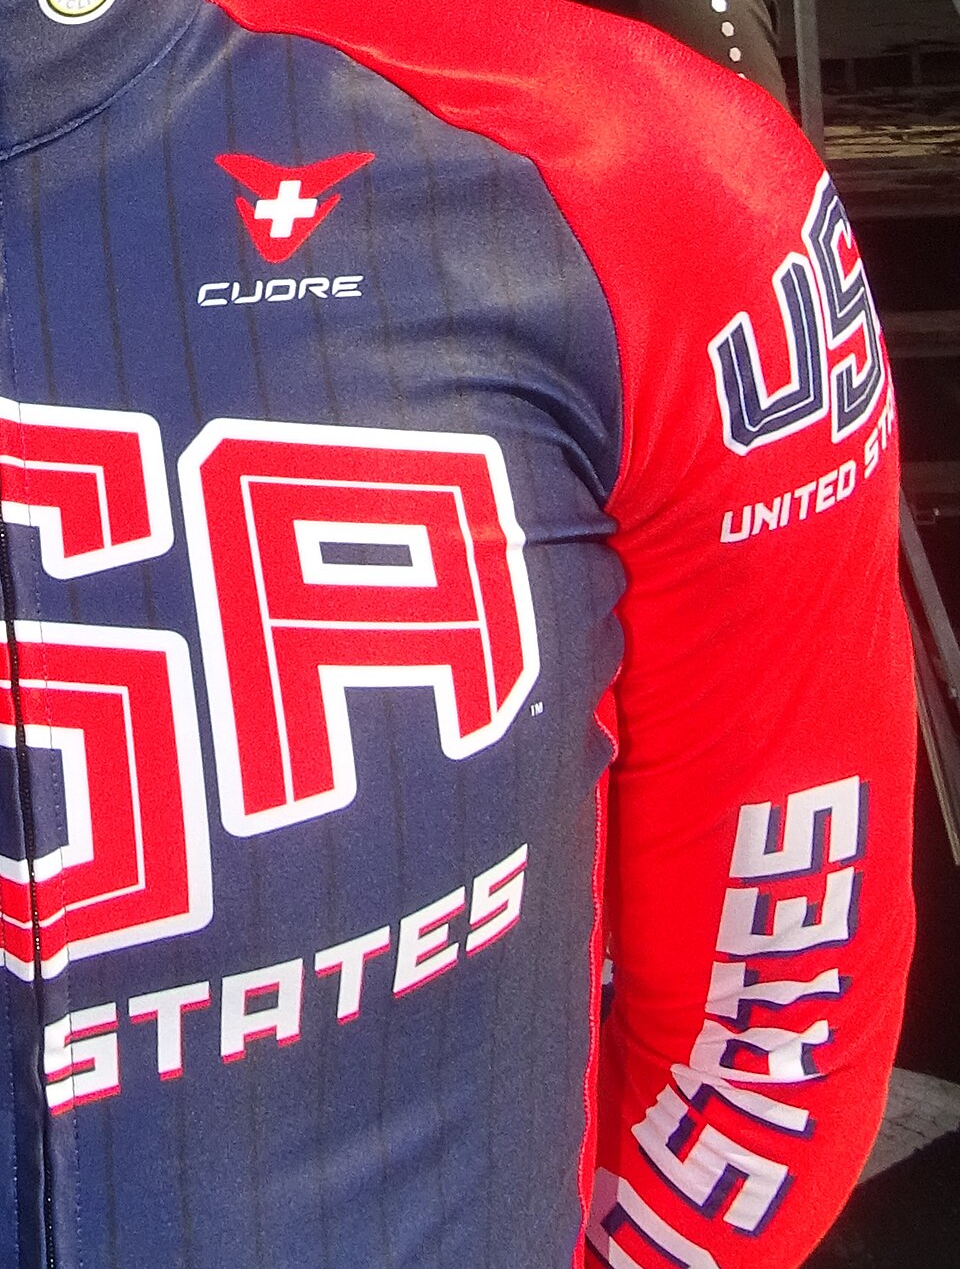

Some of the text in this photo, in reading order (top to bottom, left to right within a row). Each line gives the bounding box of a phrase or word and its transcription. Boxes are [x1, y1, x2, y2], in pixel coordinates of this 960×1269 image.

[197, 275, 364, 307] CUORE
[720, 460, 857, 544] UNITED
[43, 842, 529, 1116] STATES
[632, 774, 868, 1237] STATES
